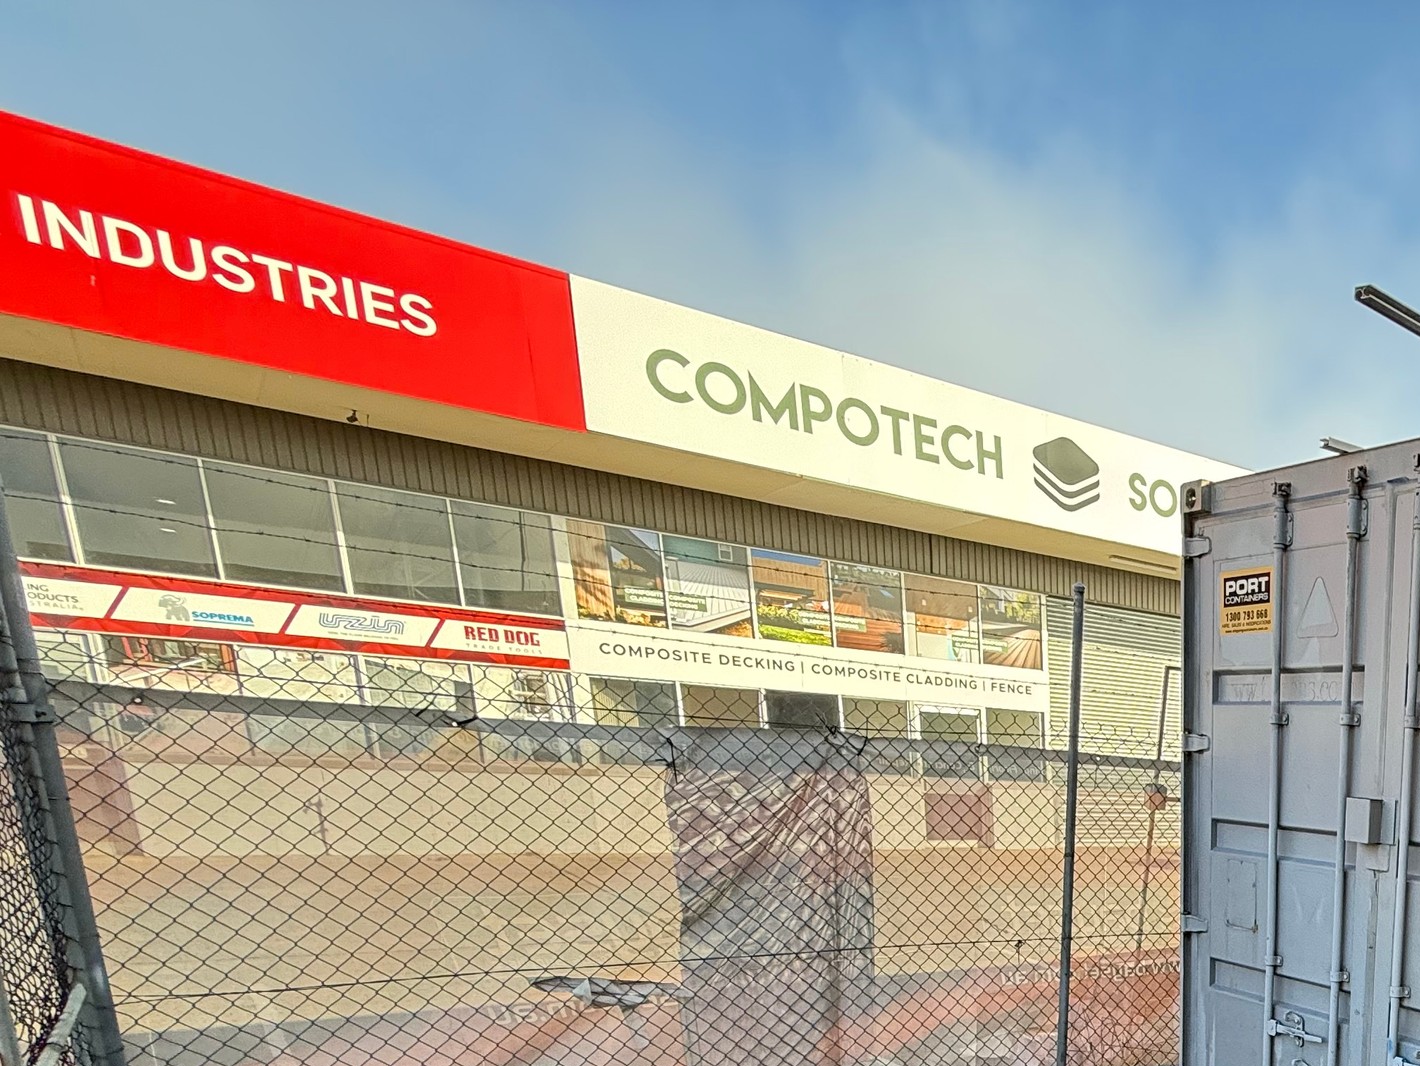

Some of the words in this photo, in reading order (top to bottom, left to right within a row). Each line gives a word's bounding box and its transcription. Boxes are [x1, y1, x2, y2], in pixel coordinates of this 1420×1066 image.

[17, 193, 438, 338] INDUSTRIES
[646, 348, 1004, 480] COMPOTECH
[1226, 576, 1269, 596] PORT
[1225, 593, 1269, 605] CONTAINERS
[192, 611, 254, 623] SOPREMA
[1226, 611, 1241, 622] 1300
[1243, 610, 1254, 620] 793
[464, 625, 499, 643] RED
[503, 629, 541, 647] DOG
[466, 643, 500, 651] TRADE
[509, 647, 543, 655] TOOLS
[599, 642, 712, 664] COMPOSITE
[719, 654, 795, 672] DECKING
[811, 664, 901, 682] COMPOSITE
[906, 673, 978, 690] CLADDING
[991, 682, 1032, 696] FENCE
